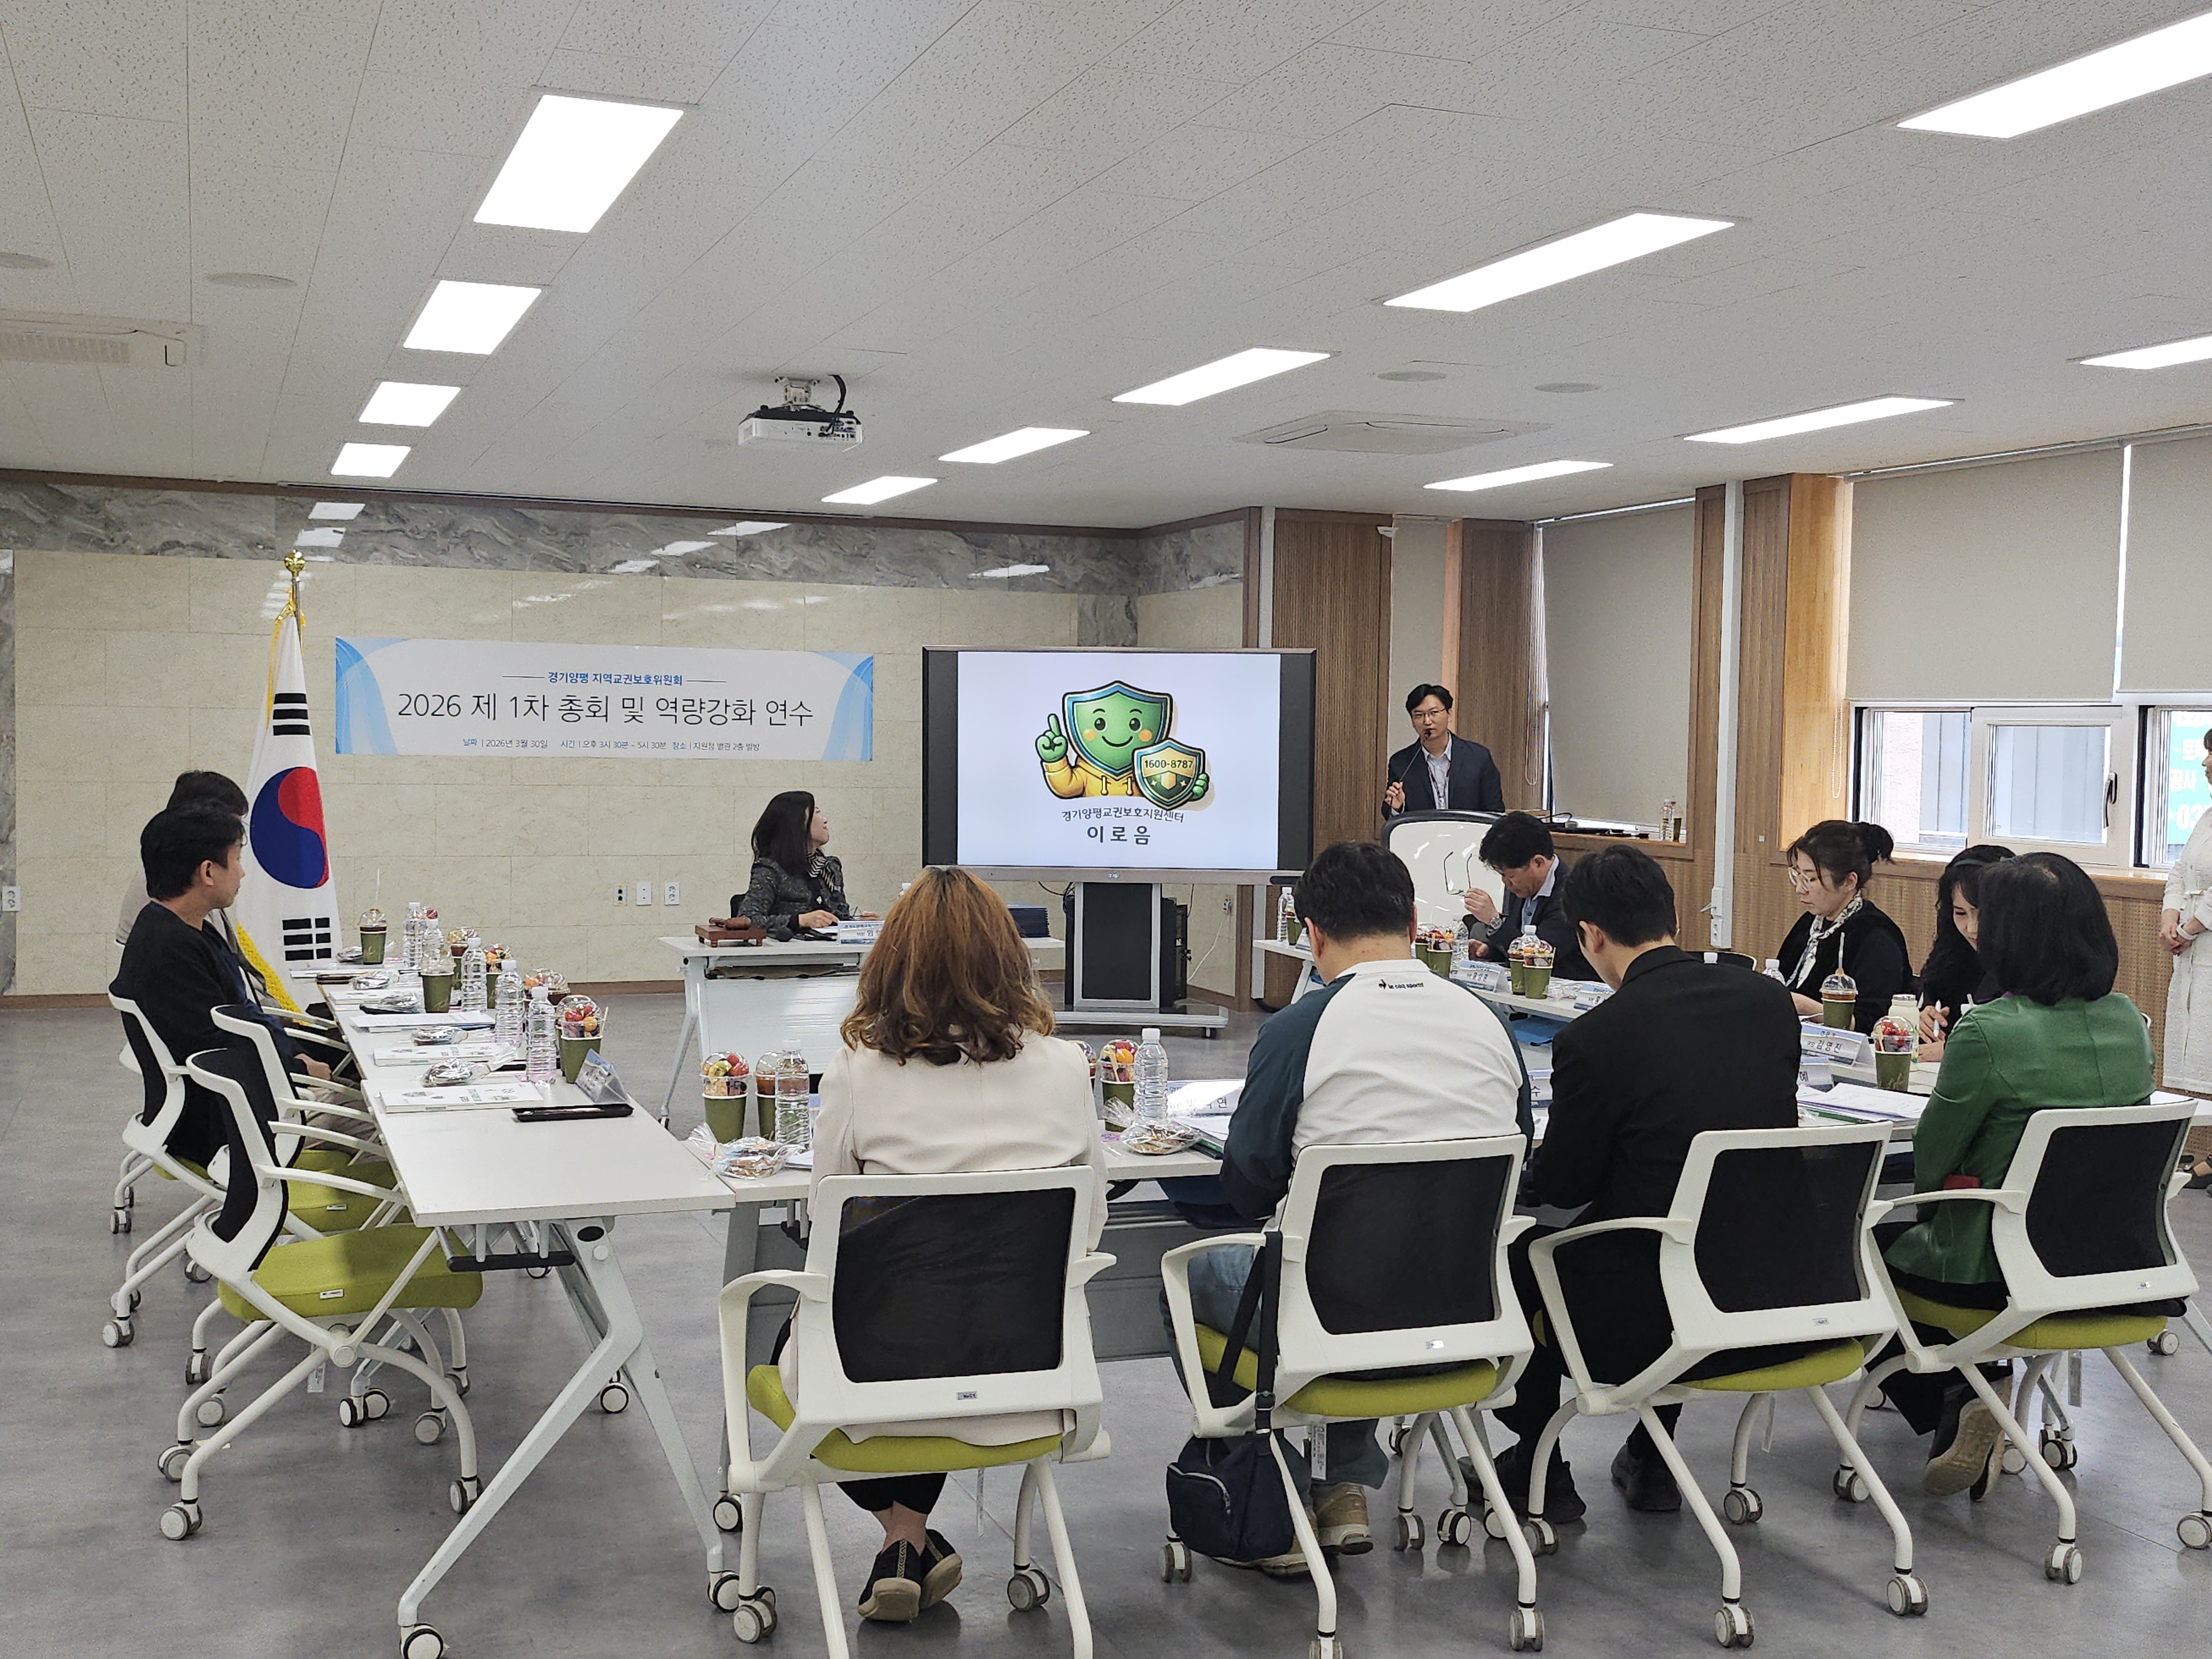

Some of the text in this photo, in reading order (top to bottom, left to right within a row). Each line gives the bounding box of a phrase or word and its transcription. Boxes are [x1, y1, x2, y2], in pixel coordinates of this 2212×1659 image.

[548, 671, 682, 686] 경기양평 지역교권보호위원회
[398, 693, 814, 727] 2026 제 1차 총회 및 역량강화 연수
[486, 739, 513, 748] 2026년
[515, 739, 528, 748] 3월
[530, 739, 548, 749] 30일
[561, 740, 575, 748] 시간
[582, 740, 596, 748] 오후
[599, 740, 611, 749] 3시
[613, 741, 629, 749] 30분
[637, 741, 649, 749] 5시
[651, 742, 666, 750] 30분
[672, 742, 686, 750] 장소
[1144, 759, 1193, 769] 1600-8787
[1062, 807, 1185, 823] 경기양평교권보호지원센터
